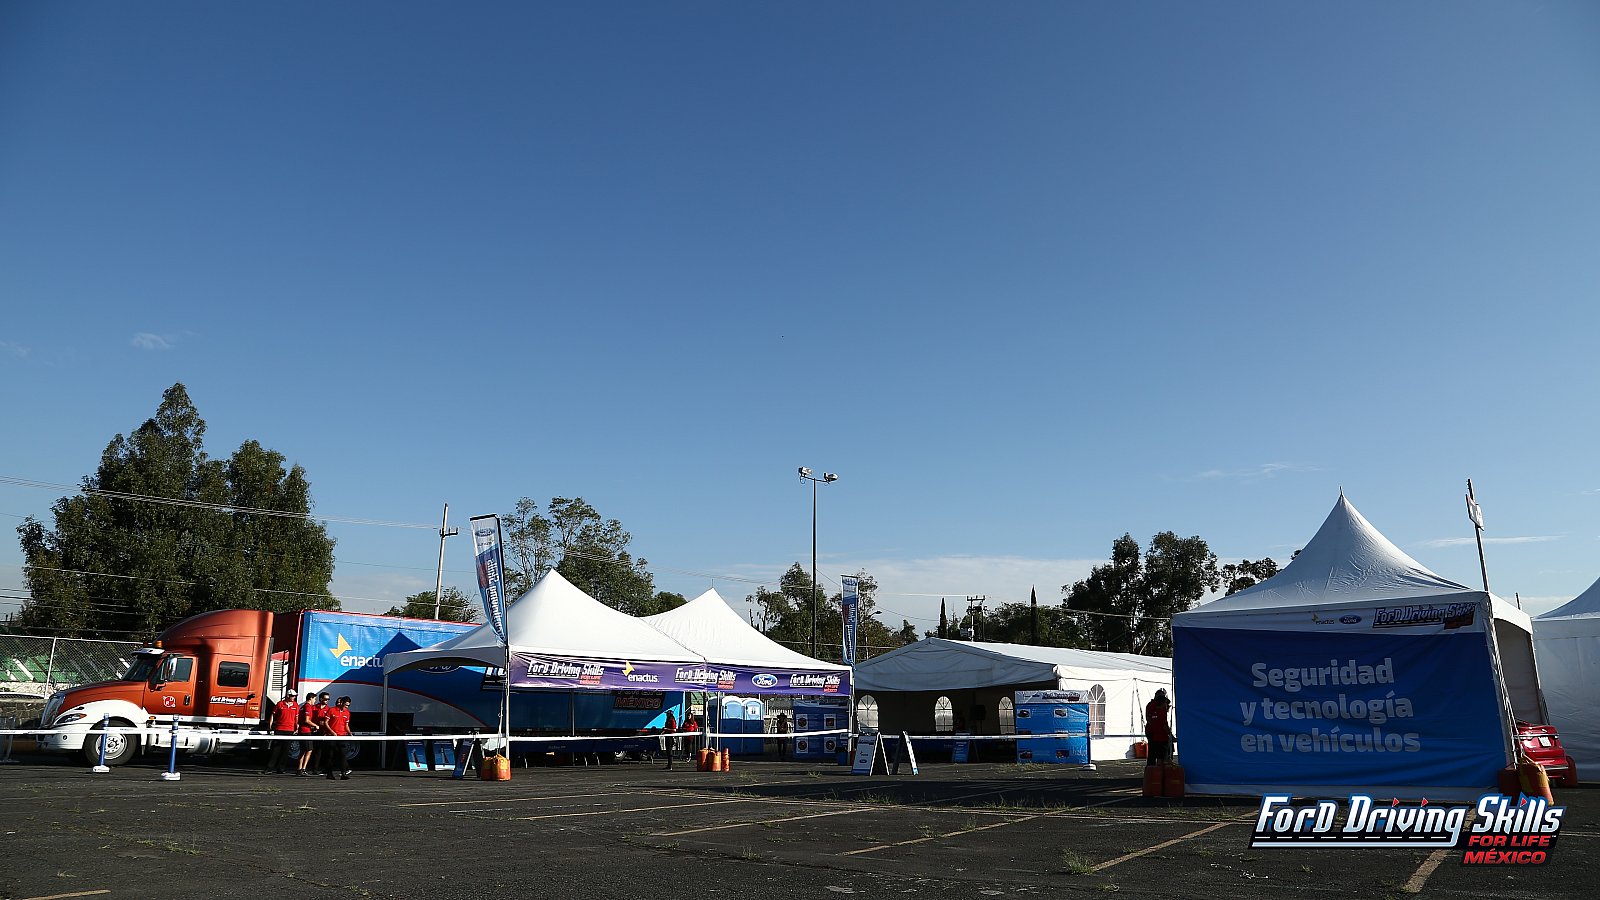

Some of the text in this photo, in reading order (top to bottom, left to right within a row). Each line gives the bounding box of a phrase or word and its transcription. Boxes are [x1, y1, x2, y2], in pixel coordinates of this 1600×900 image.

[1404, 605, 1445, 624] Driving
[1446, 602, 1476, 618] Skills
[340, 655, 384, 667] enactu
[550, 661, 581, 679] Driving
[582, 662, 605, 676] Skills
[1251, 657, 1395, 692] Seguridad
[1240, 690, 1414, 726] y tecnología
[1240, 725, 1421, 753] en vehículos
